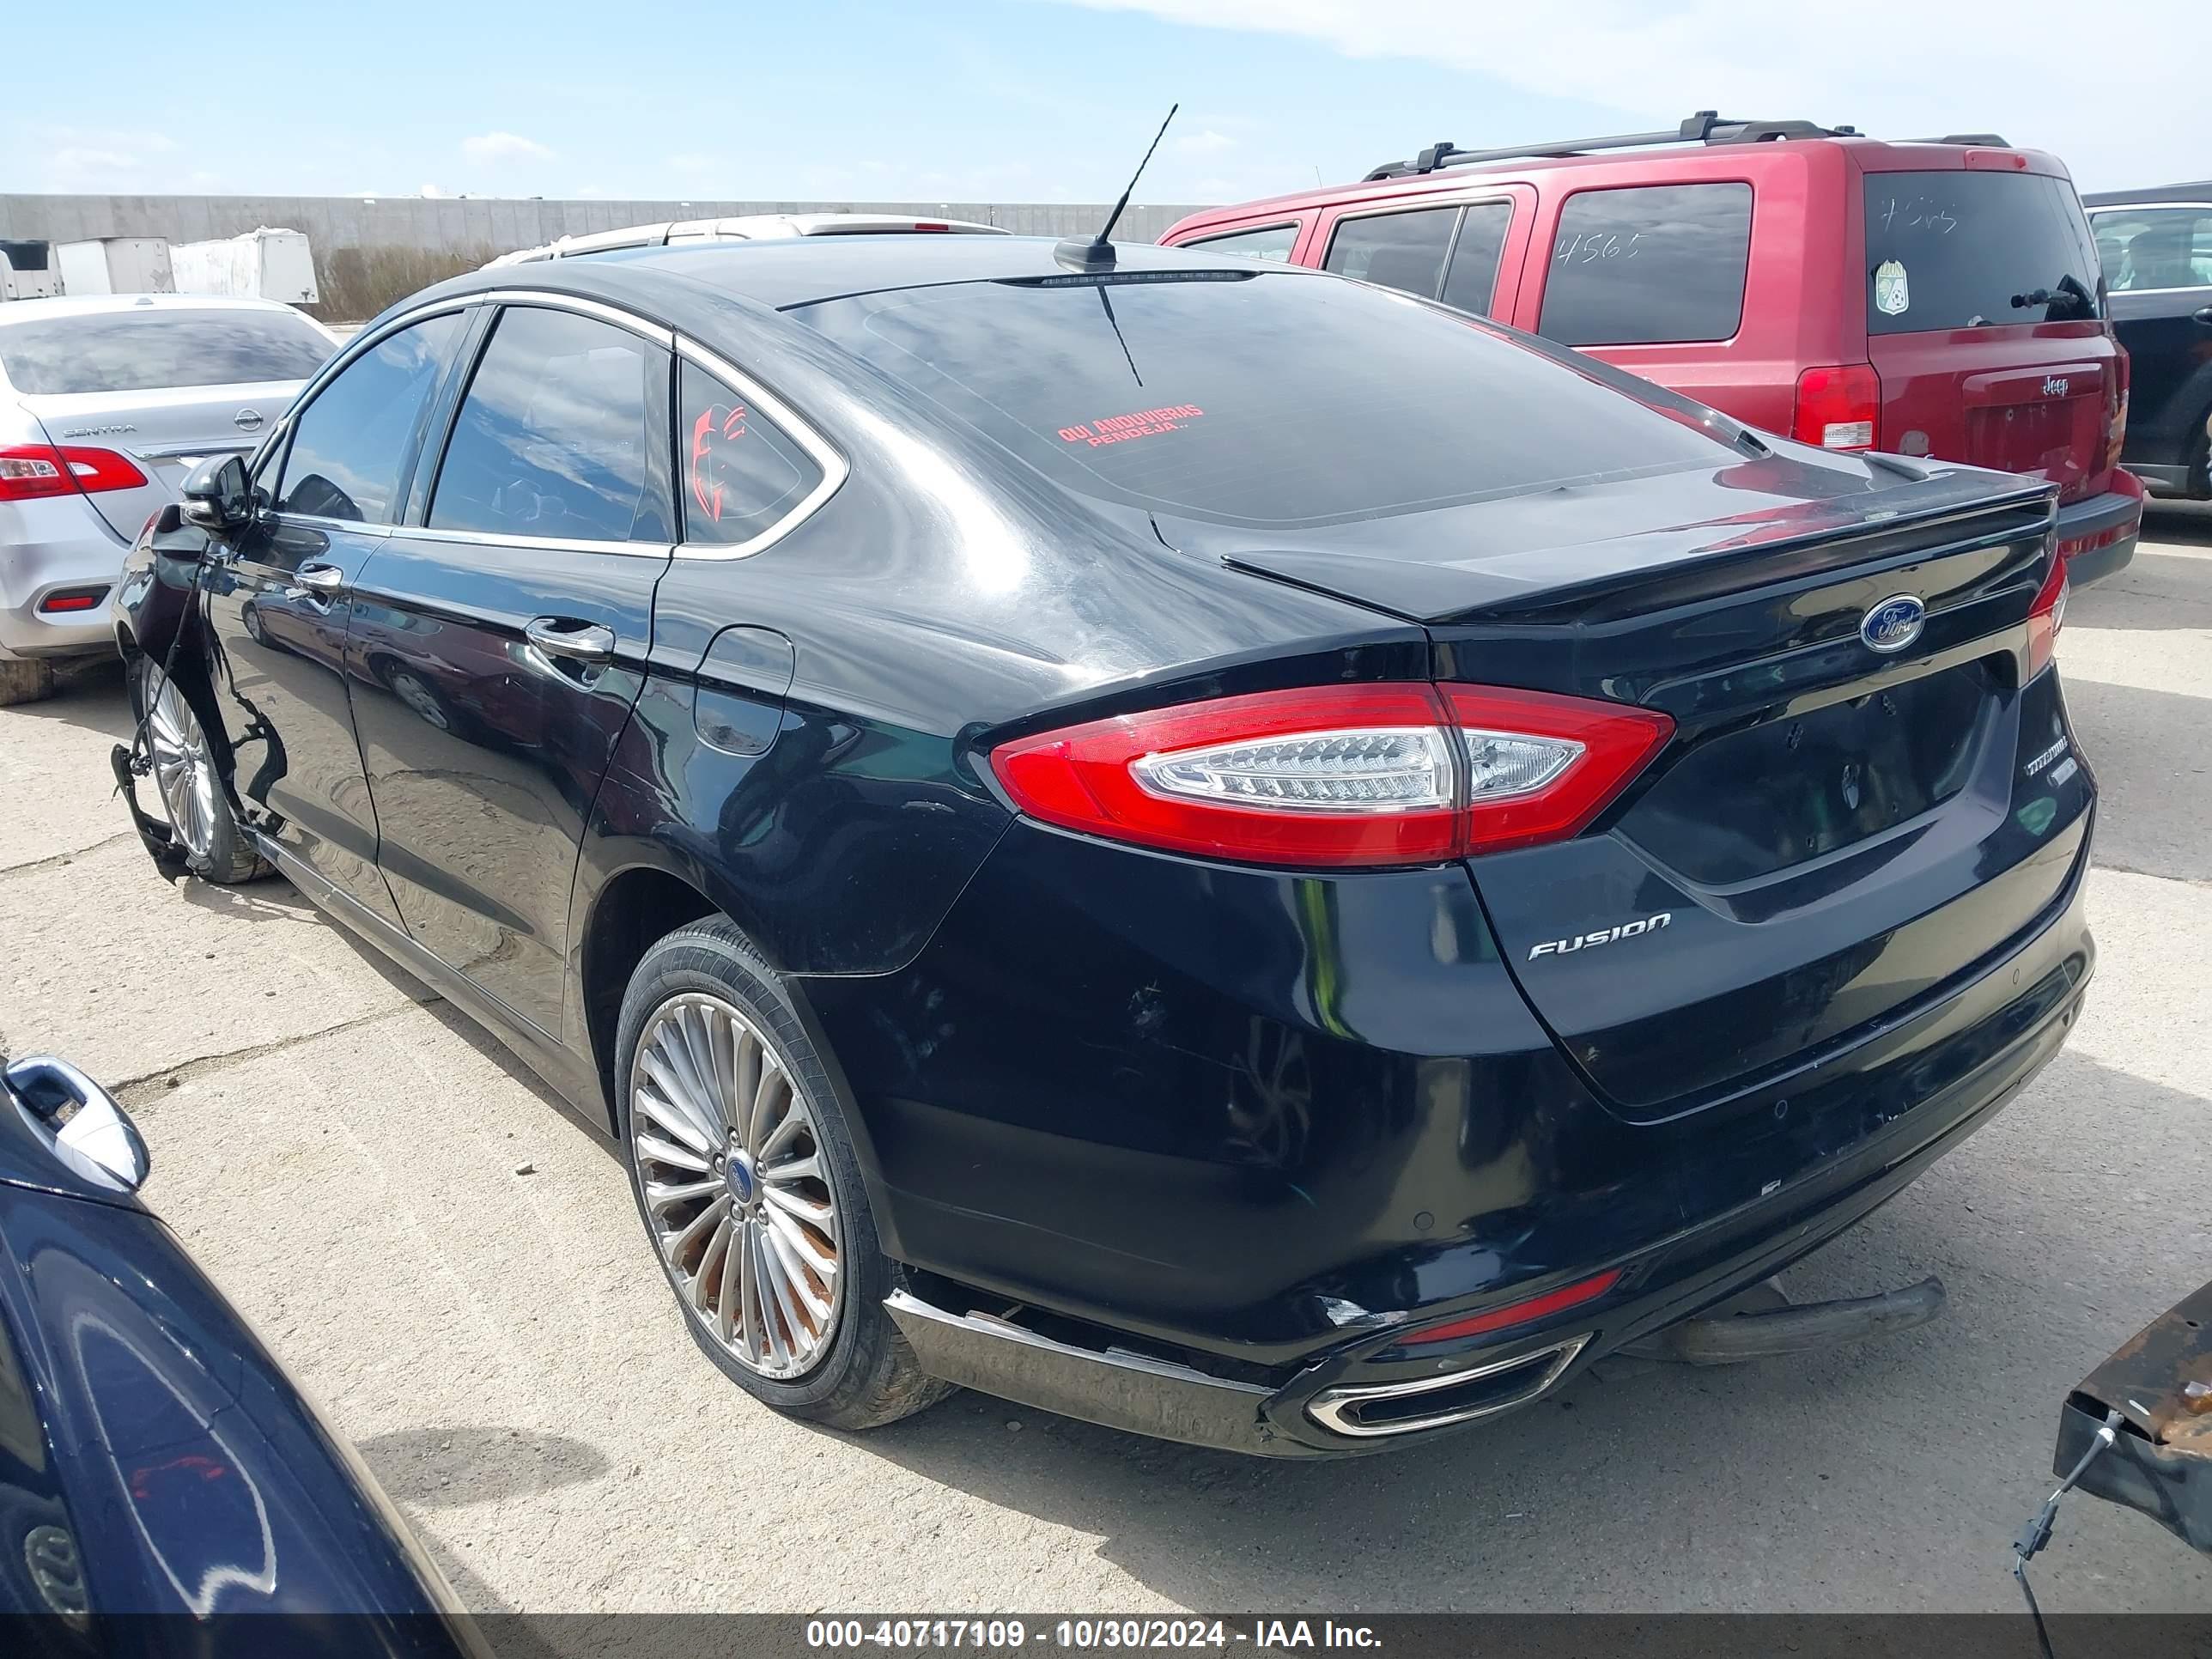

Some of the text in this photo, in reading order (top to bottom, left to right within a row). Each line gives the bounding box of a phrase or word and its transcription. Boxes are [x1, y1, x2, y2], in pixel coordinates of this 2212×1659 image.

[1558, 233, 1649, 267] 4565
[2042, 375, 2069, 397] Jeep
[63, 424, 137, 438] SENTRA
[1091, 404, 1204, 434] ANDUVIERAS
[1528, 913, 1672, 962] FUSION
